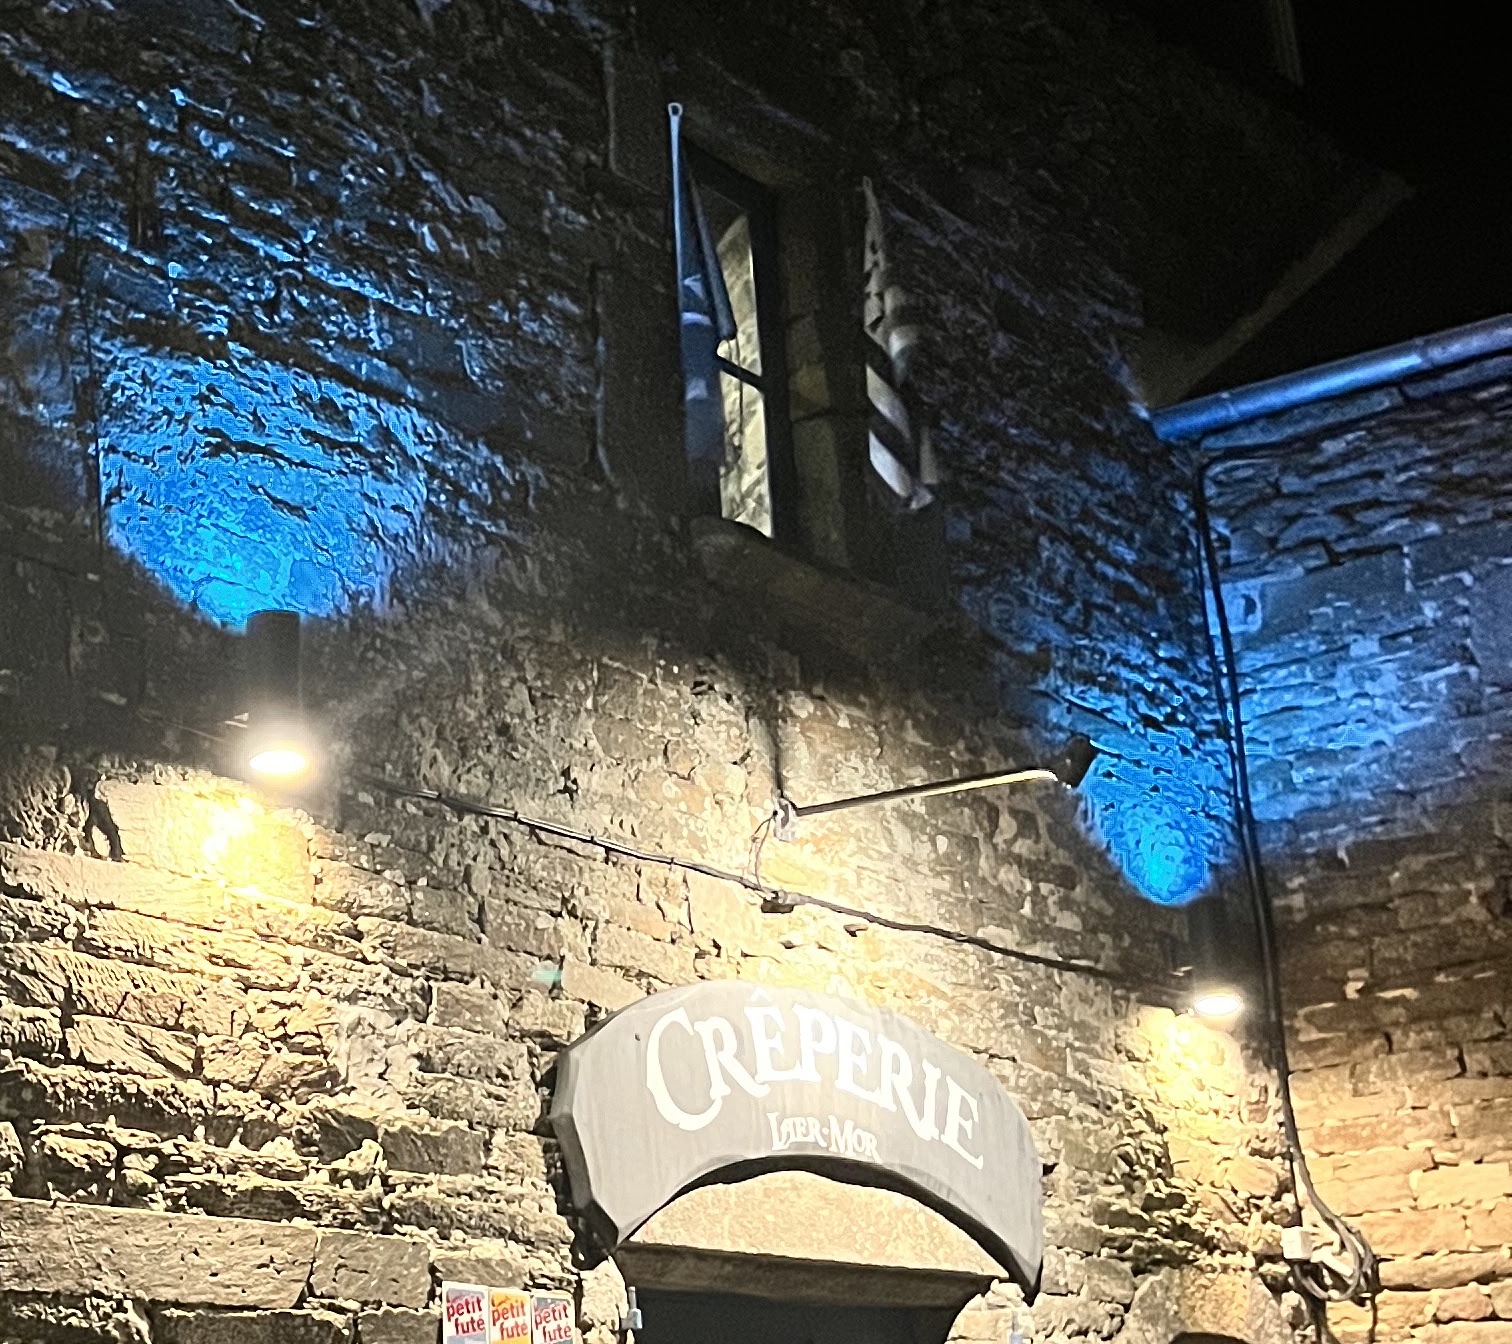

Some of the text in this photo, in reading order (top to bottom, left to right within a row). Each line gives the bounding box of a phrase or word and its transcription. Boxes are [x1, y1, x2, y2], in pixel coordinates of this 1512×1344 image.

[646, 987, 985, 1170] CRÊPERIE
[446, 1296, 483, 1323] petit
[491, 1299, 527, 1327] petit
[534, 1303, 569, 1331] petit
